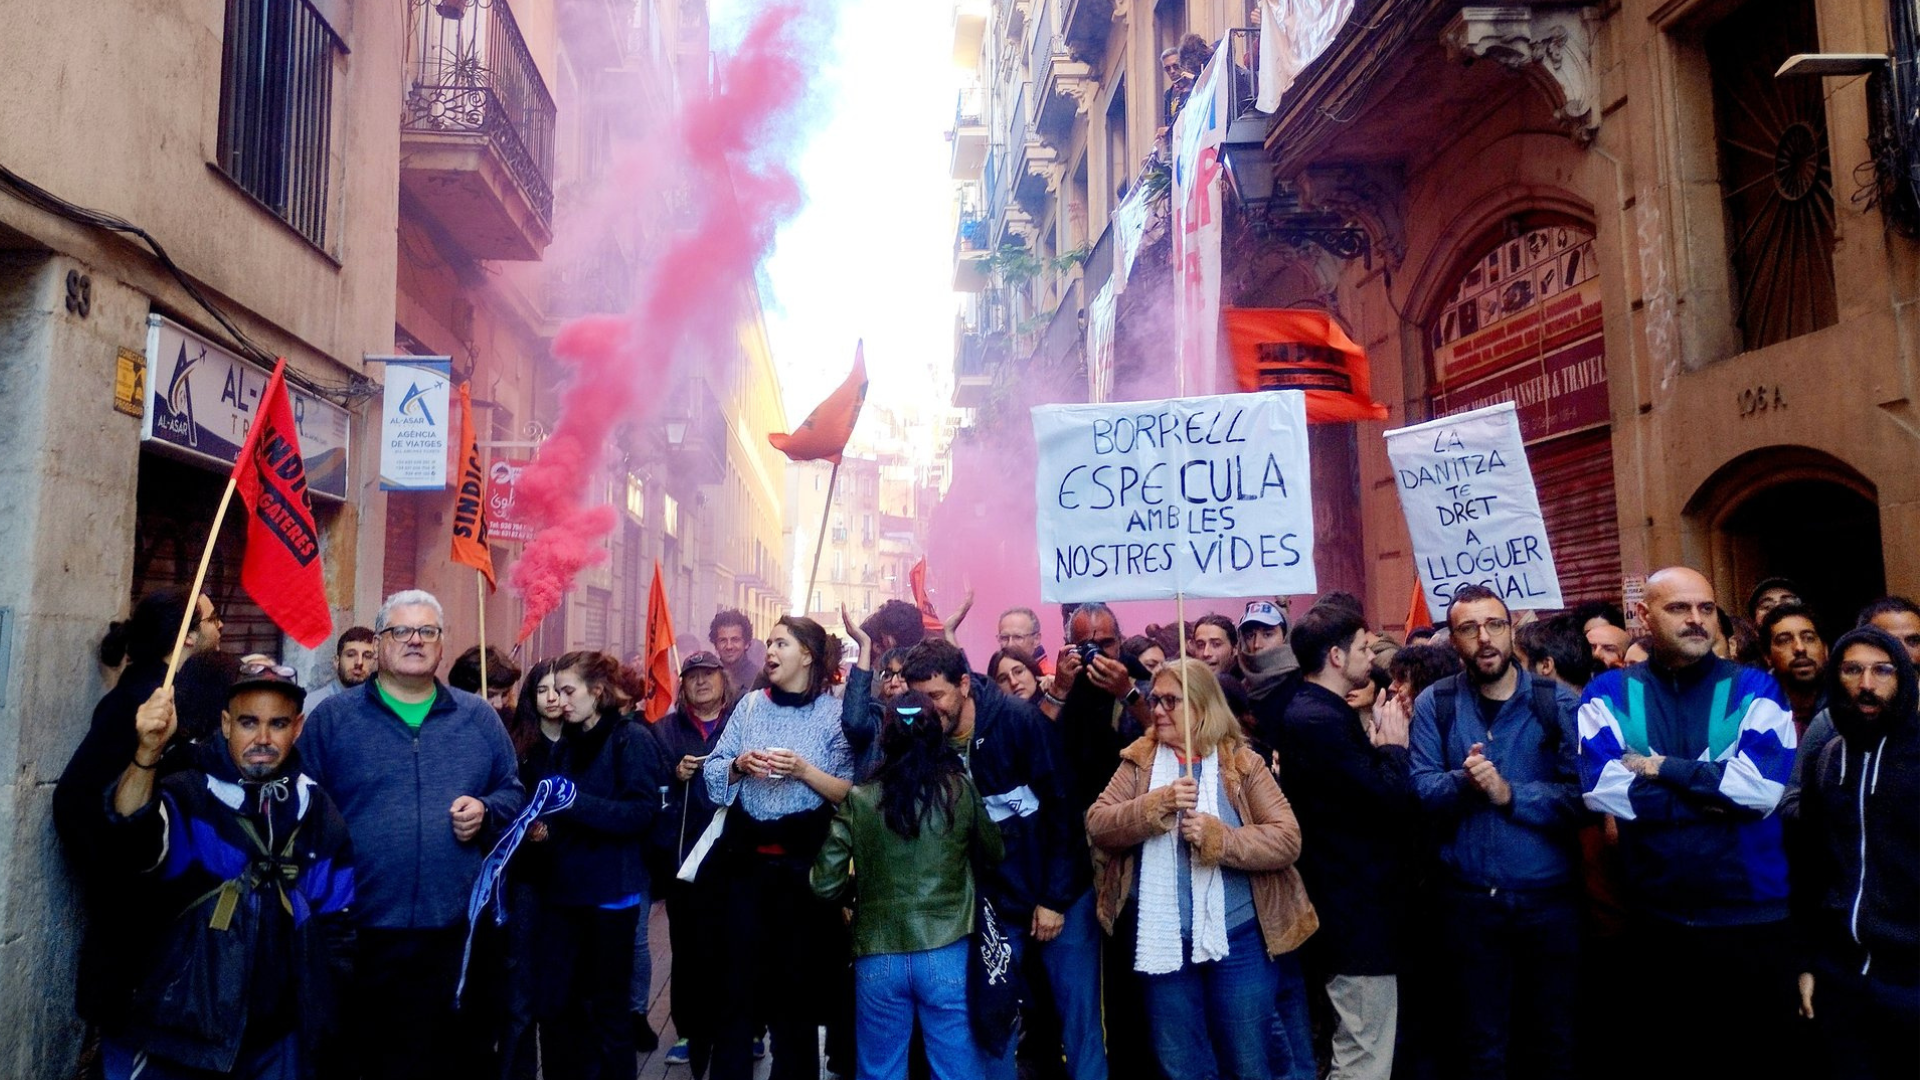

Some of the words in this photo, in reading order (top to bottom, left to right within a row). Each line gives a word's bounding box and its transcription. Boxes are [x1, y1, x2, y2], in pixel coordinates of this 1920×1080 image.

[66, 269, 91, 318] 93
[157, 415, 188, 436] AL-ASAR
[1093, 410, 1246, 454] BORRELL
[391, 440, 403, 448] DE
[405, 440, 442, 448] VIATGES
[1434, 430, 1464, 453] LA
[1059, 452, 1287, 510] ESPECULA
[1445, 484, 1471, 500] TE
[258, 494, 315, 556] GATERES
[1126, 506, 1180, 532] AMB
[1189, 506, 1236, 534] LES
[1436, 496, 1497, 526] DRET
[1466, 529, 1481, 546] A
[1056, 543, 1176, 583] NOSTRES
[1427, 536, 1543, 580] LLOGUER
